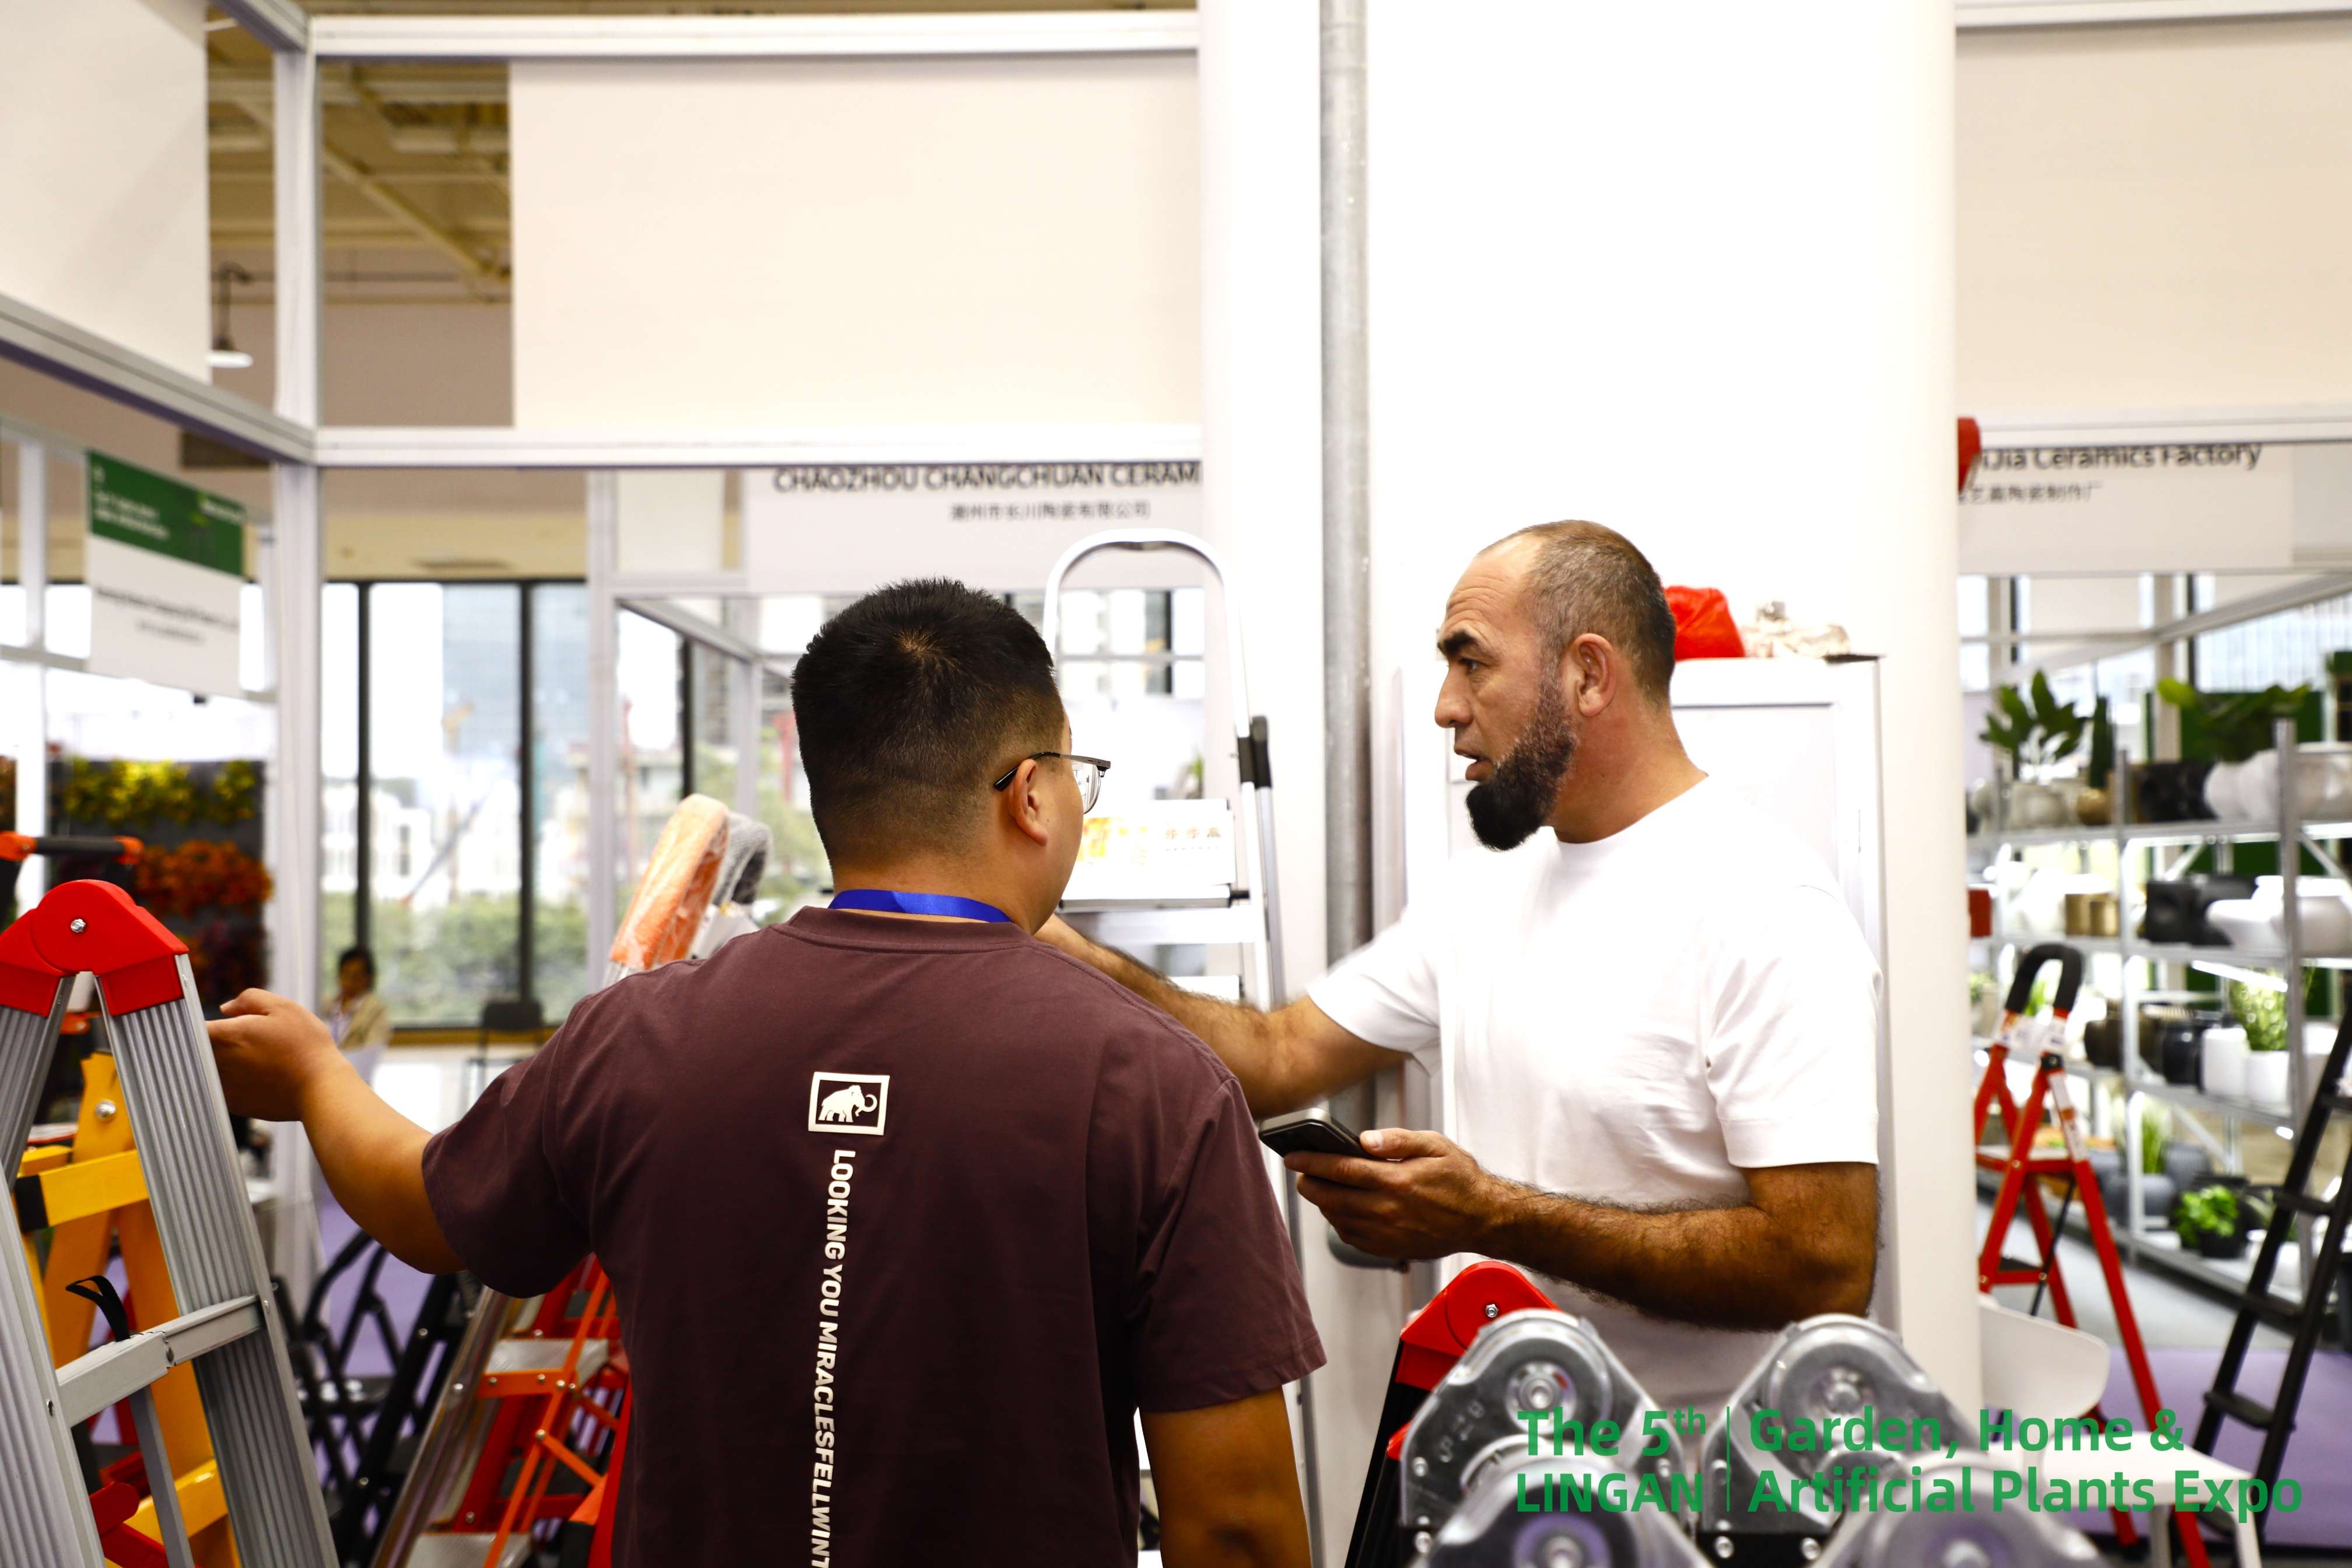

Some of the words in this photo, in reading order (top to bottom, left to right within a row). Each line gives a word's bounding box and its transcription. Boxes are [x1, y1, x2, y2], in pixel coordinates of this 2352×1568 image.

[2032, 447, 2155, 468] Ceramics
[774, 466, 918, 492] CHAOZHOU
[925, 464, 1103, 489] CHANGCHUAN
[825, 1150, 856, 1259] LOOKING
[820, 1264, 843, 1317] YOU
